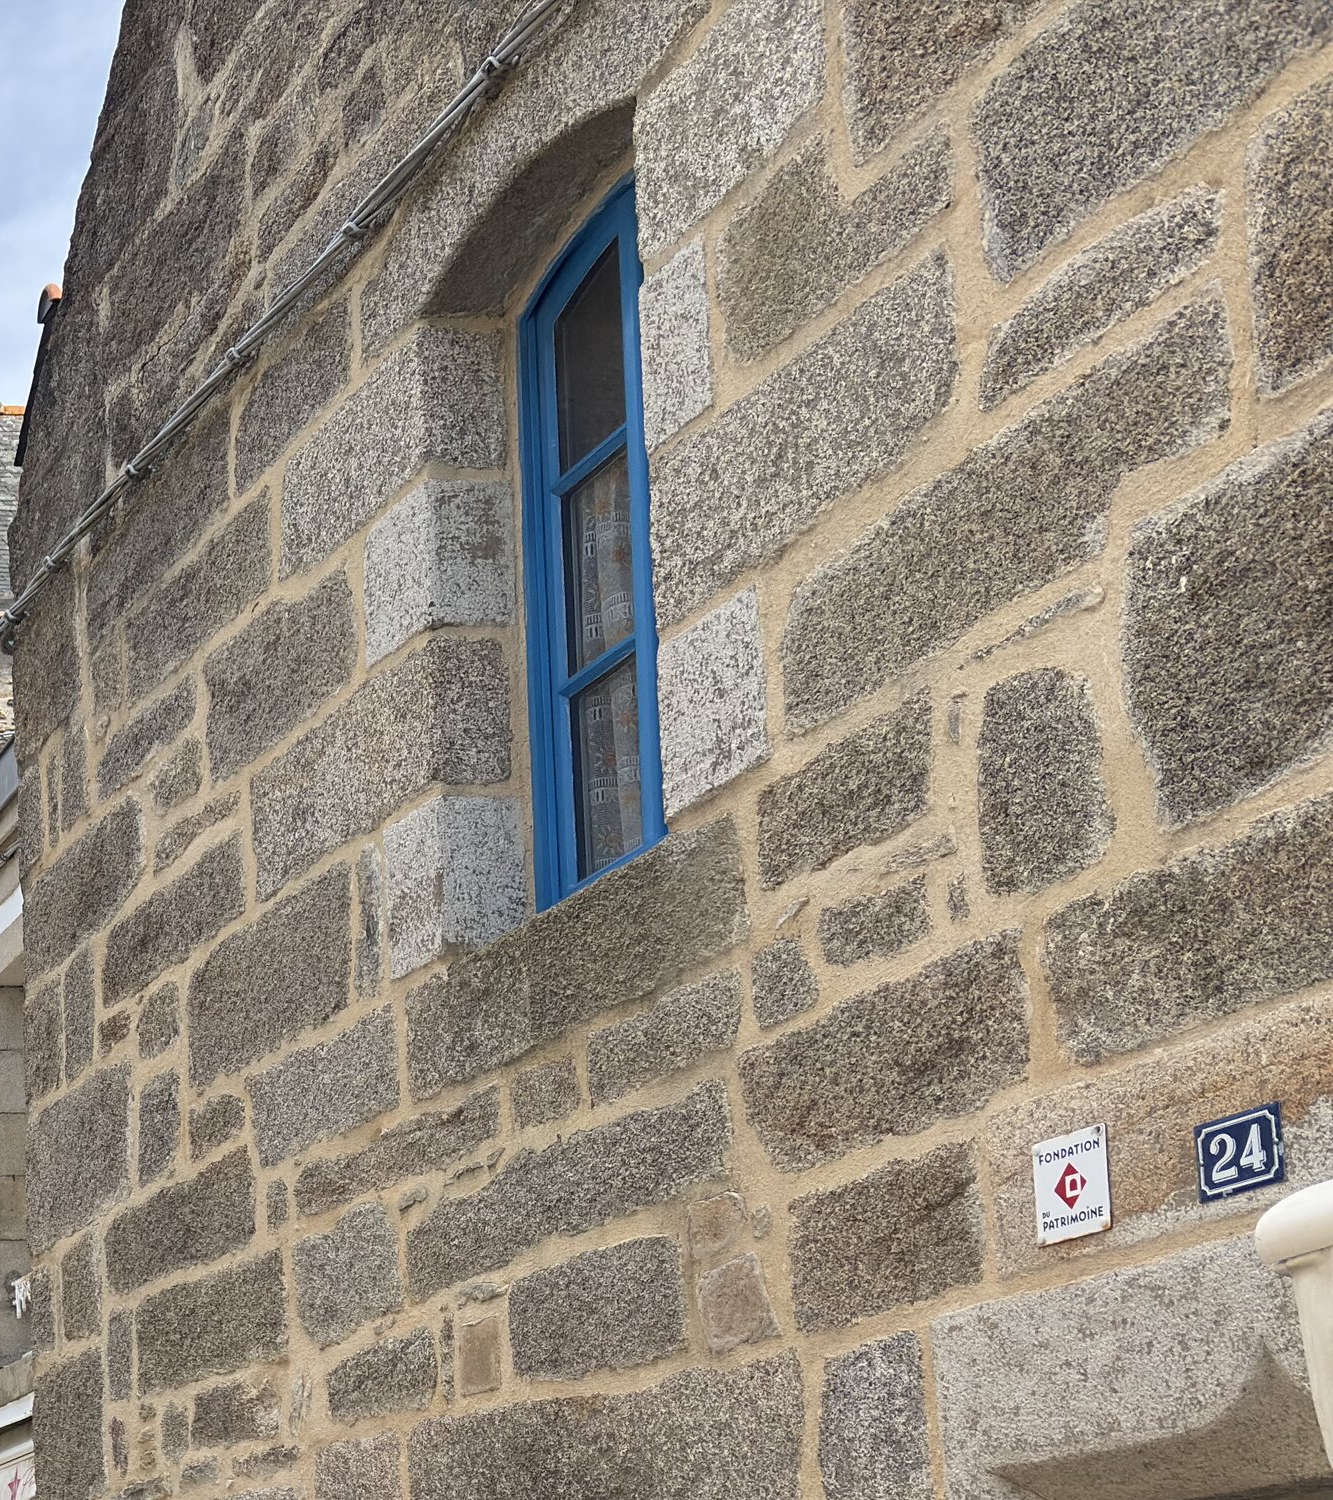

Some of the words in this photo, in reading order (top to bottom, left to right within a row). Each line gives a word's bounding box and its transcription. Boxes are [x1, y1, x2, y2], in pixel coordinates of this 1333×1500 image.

[1038, 1137, 1101, 1166] FONDATION
[1209, 1122, 1267, 1184] 24
[1042, 1210, 1051, 1219] DU
